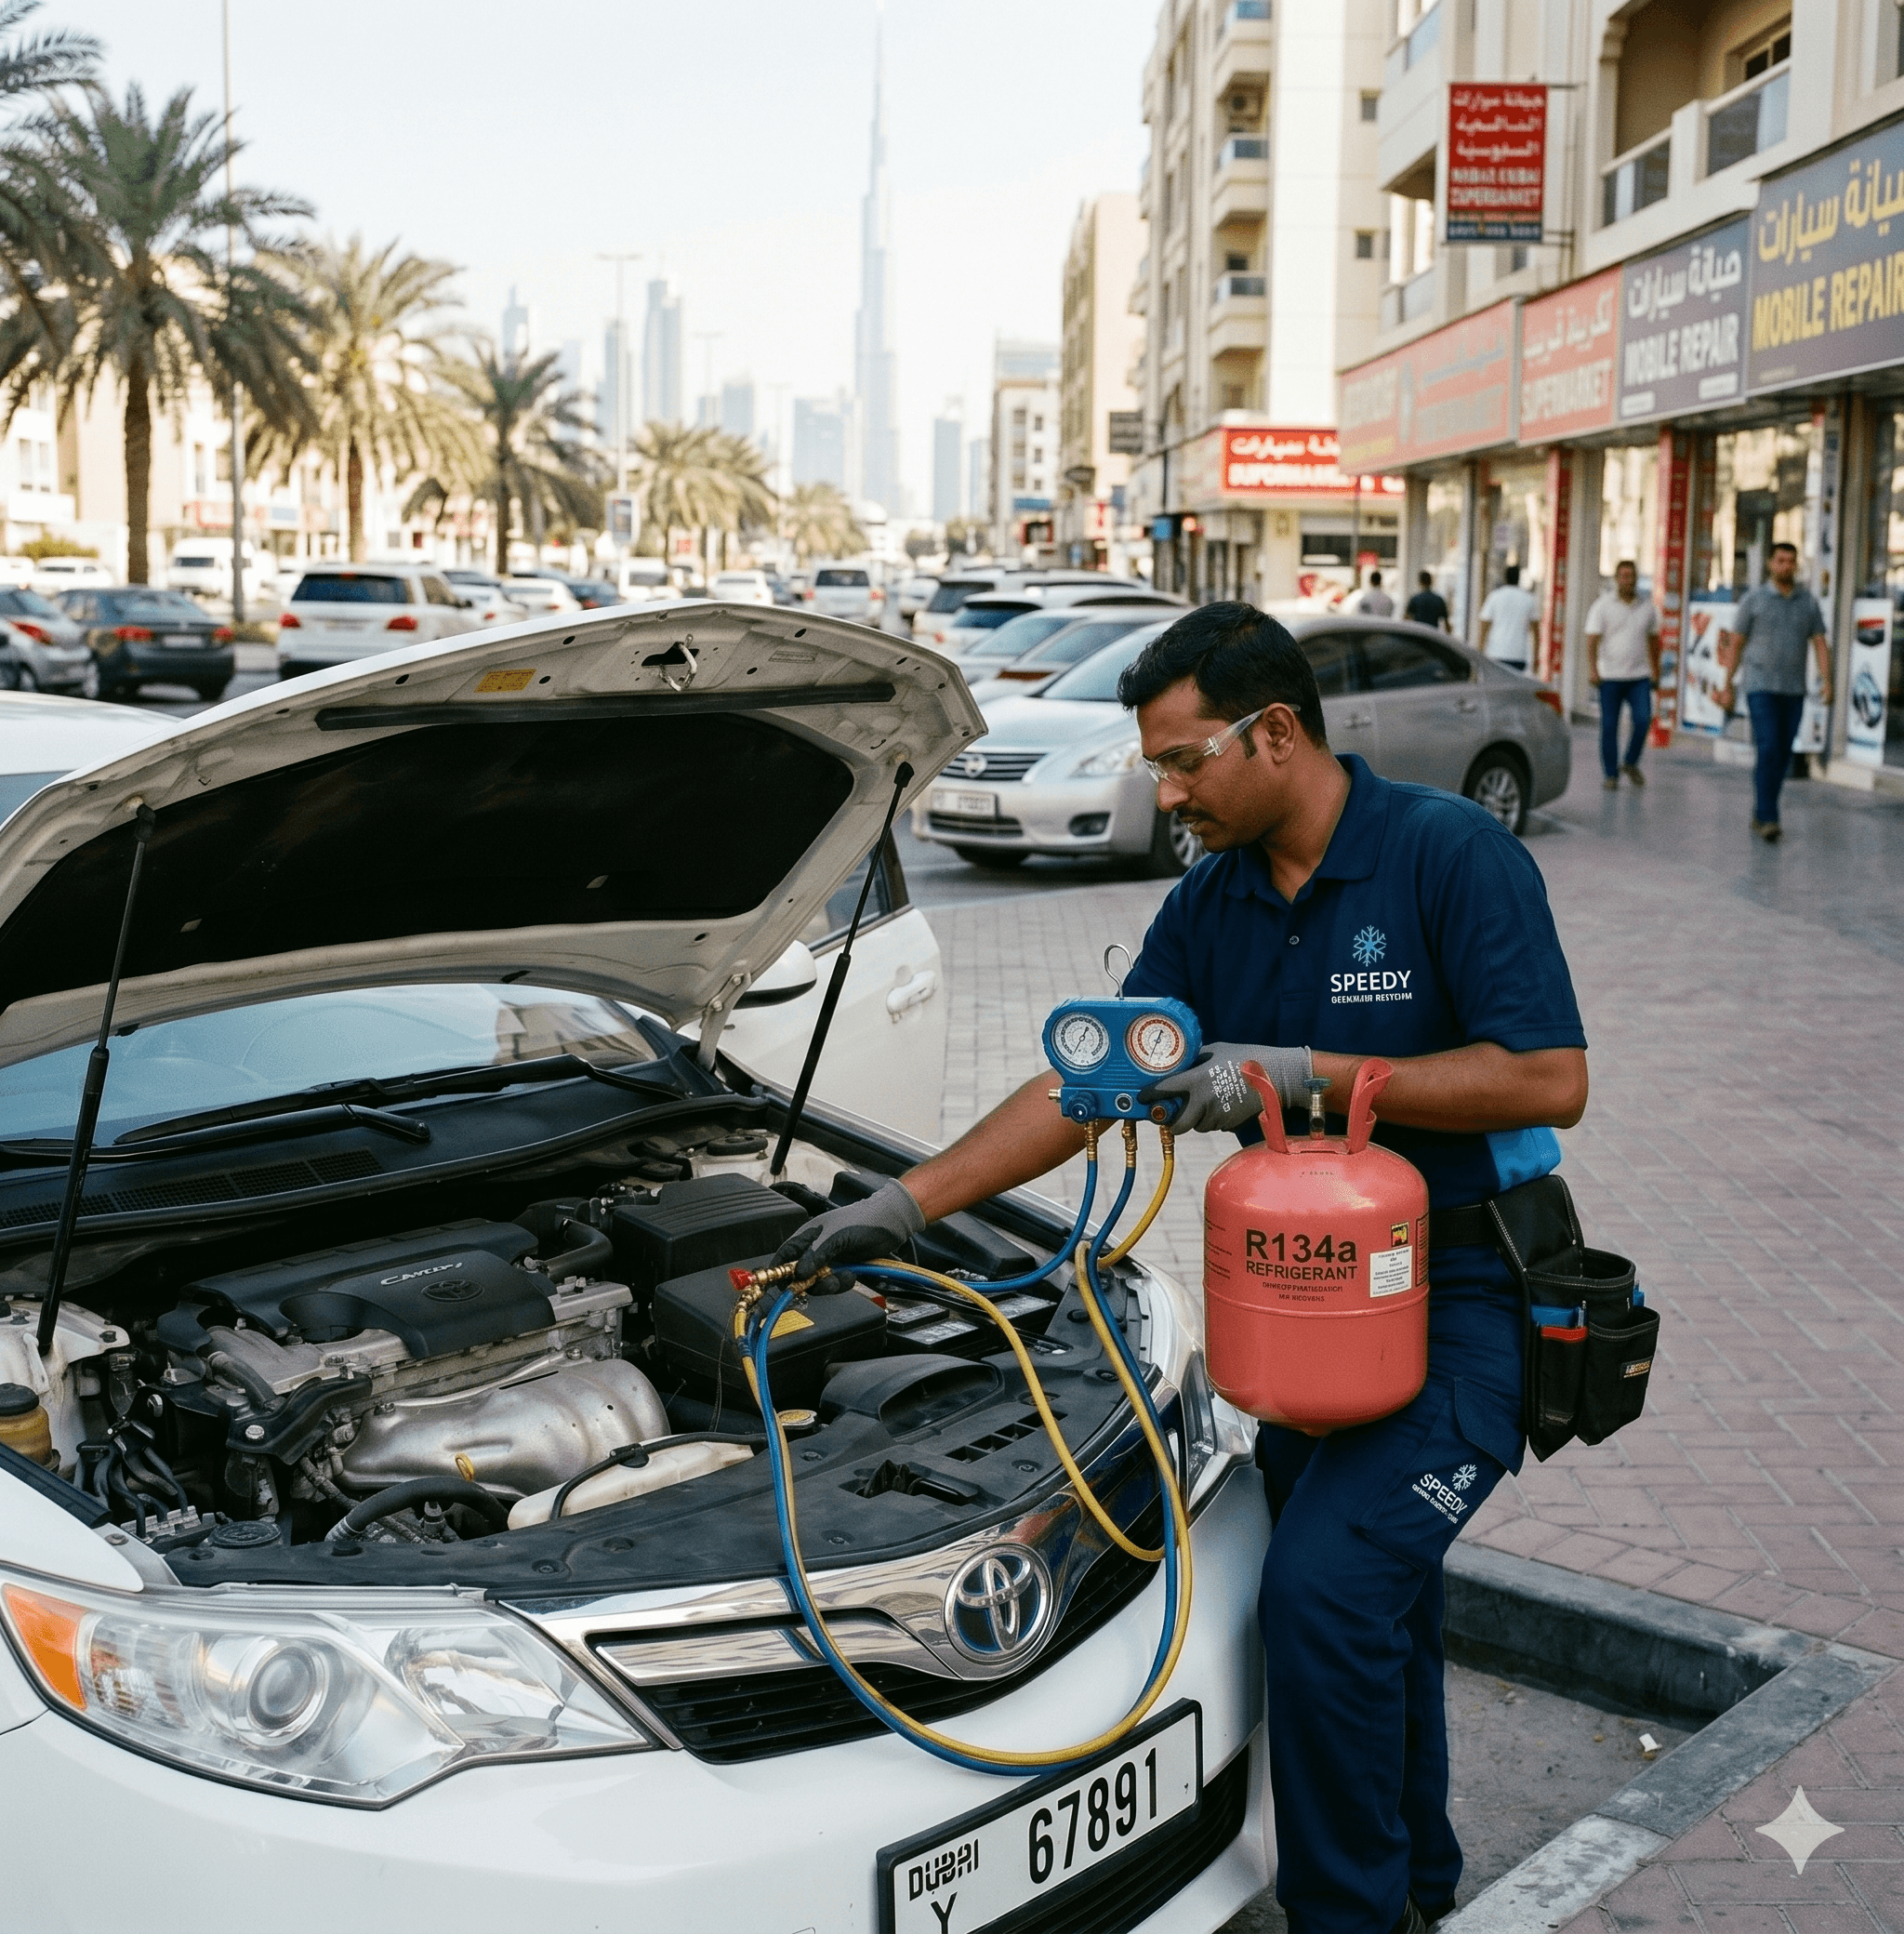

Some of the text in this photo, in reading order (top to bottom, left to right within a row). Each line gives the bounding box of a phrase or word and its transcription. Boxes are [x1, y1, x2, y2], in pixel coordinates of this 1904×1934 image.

[1758, 158, 1904, 266] يانة سيارات
[1752, 249, 1904, 352] MOBILE REPAIR
[1625, 328, 1679, 388] MOBILE
[1680, 312, 1739, 373] REPAIR
[1330, 970, 1411, 992] SPEEDY
[1246, 1228, 1357, 1264] R134a
[1246, 1260, 1358, 1280] REFRIGERANT
[1420, 1473, 1468, 1515] SPEEDY
[1028, 1747, 1157, 1885] 67891
[908, 1838, 979, 1901] DUBAI
[930, 1891, 958, 1934] Y
